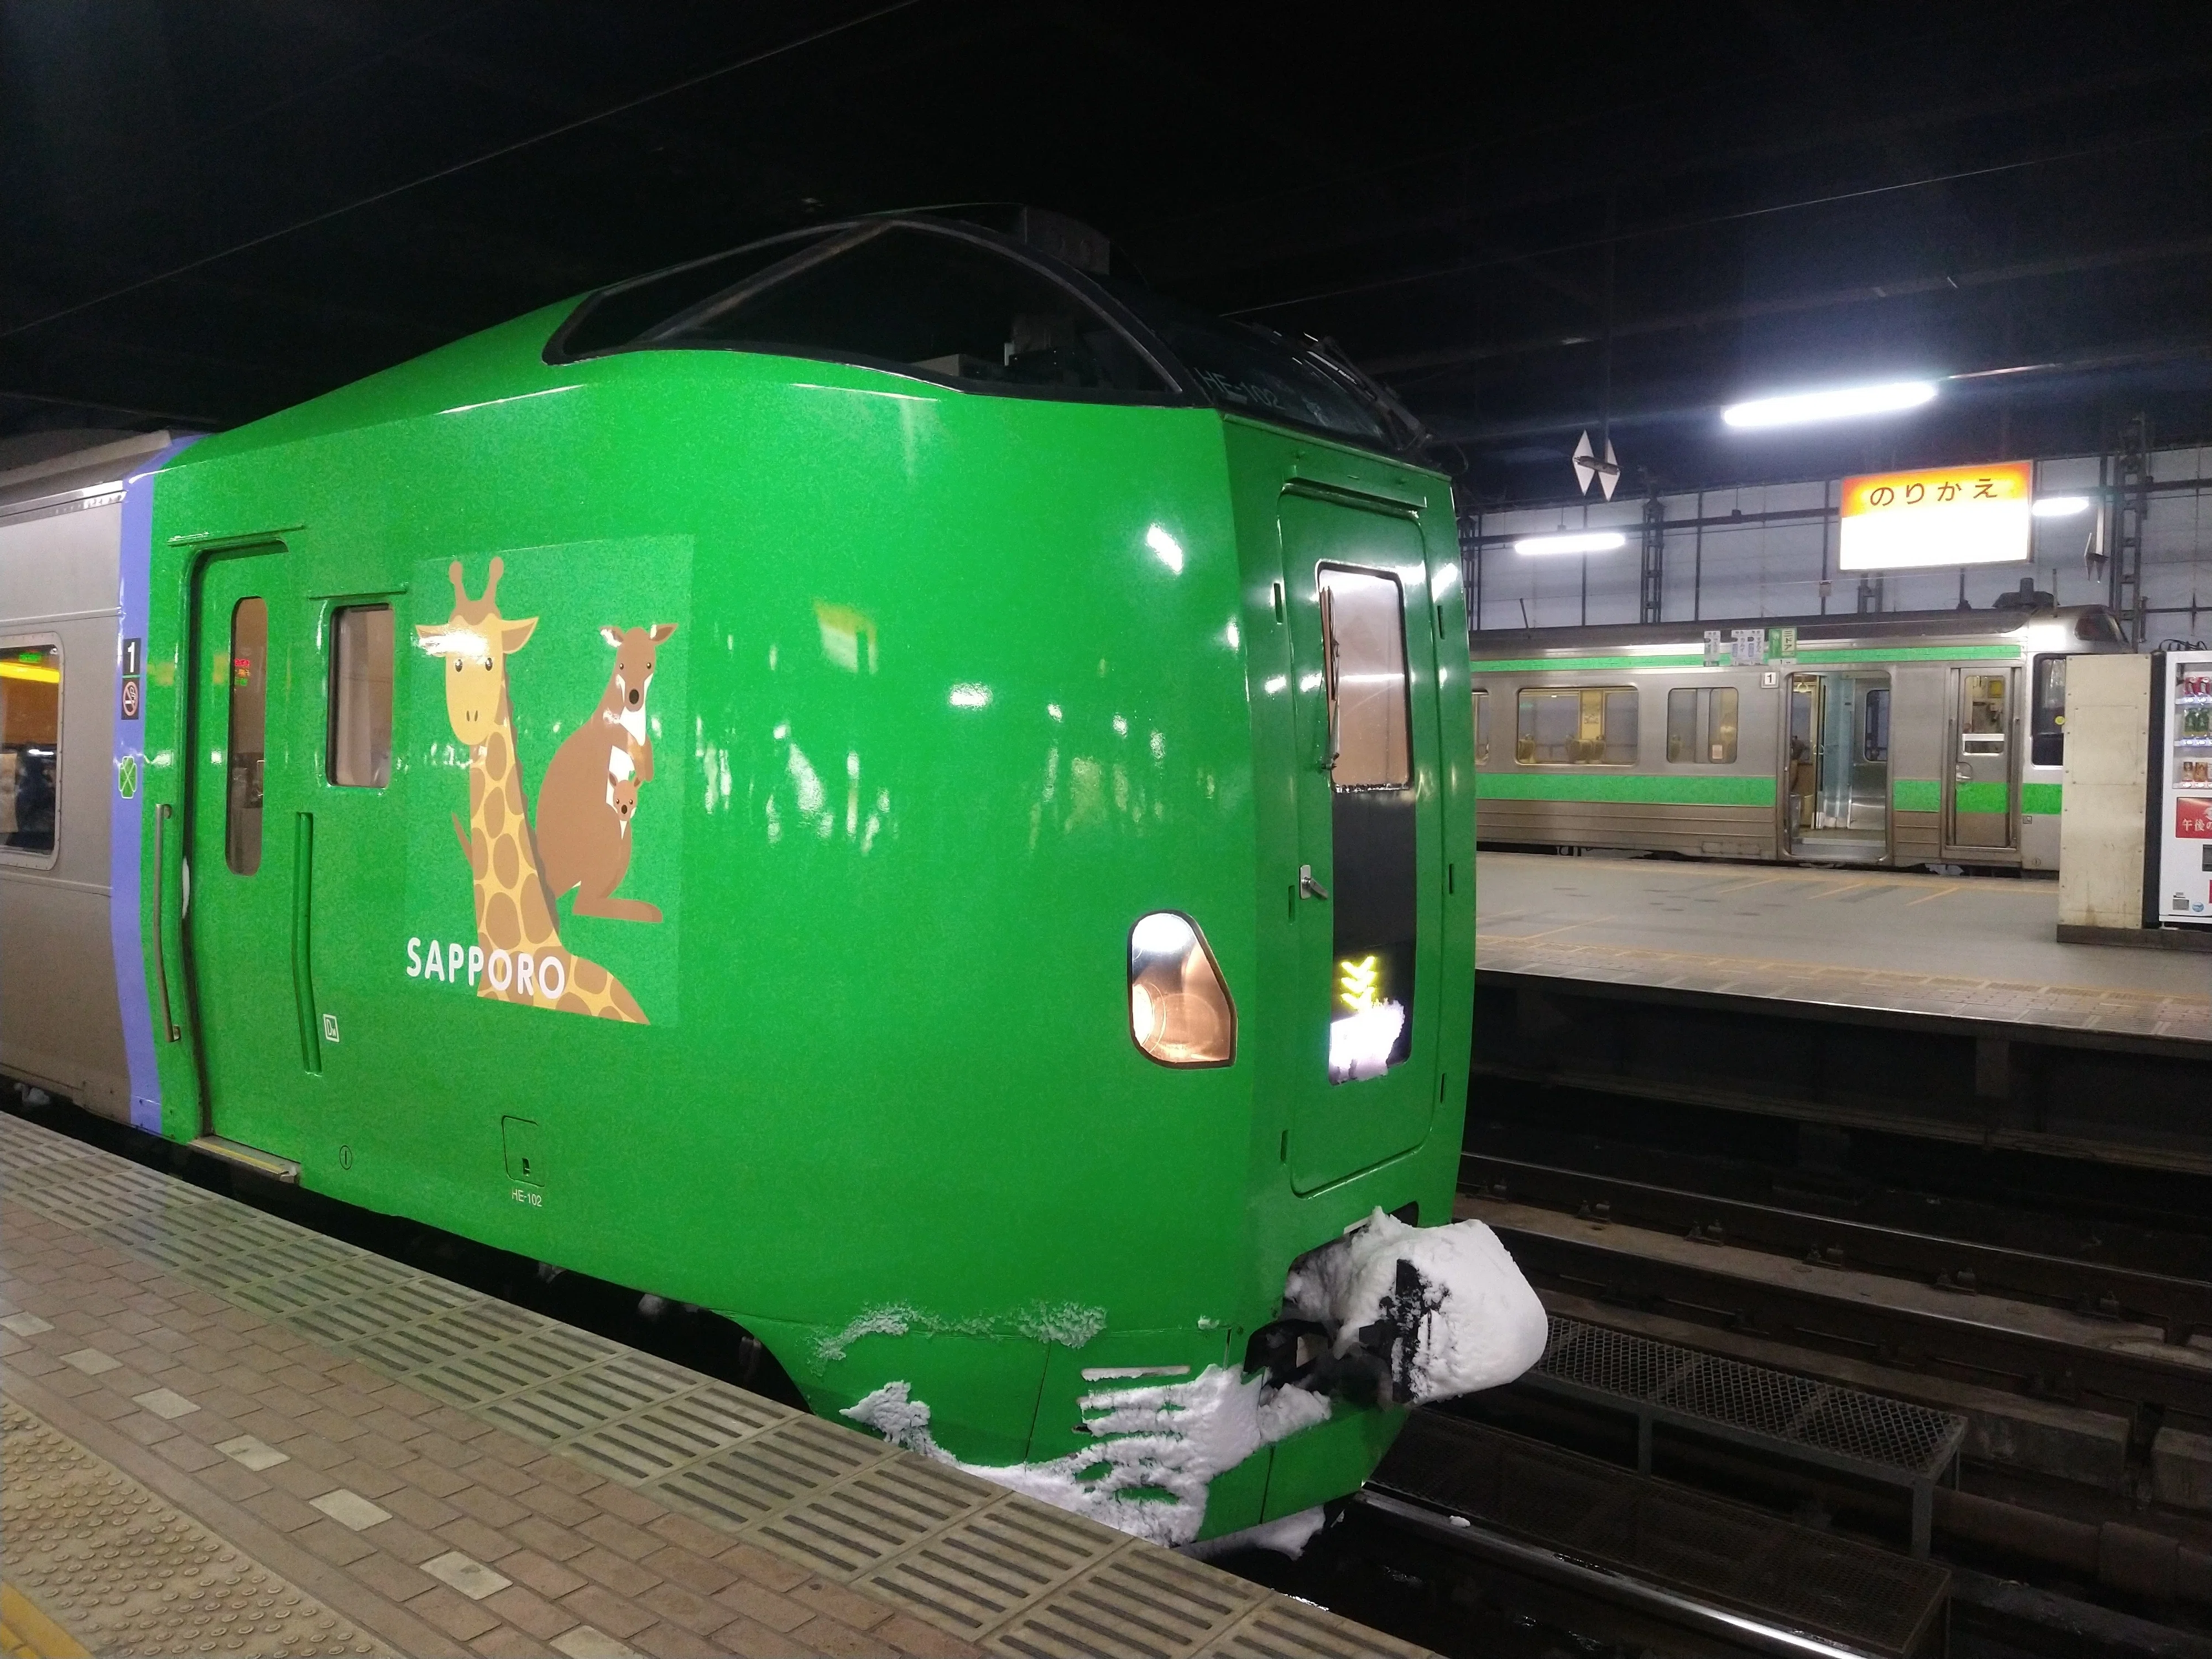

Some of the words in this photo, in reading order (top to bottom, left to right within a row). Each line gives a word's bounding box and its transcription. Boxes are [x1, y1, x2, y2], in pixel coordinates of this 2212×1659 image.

[1193, 367, 1286, 410] HE-102
[1870, 478, 1997, 507] のりかえ
[127, 641, 135, 673] 1
[1767, 674, 1772, 684] 1
[406, 937, 565, 999] SAPPORO
[512, 1189, 542, 1207] HE-102
